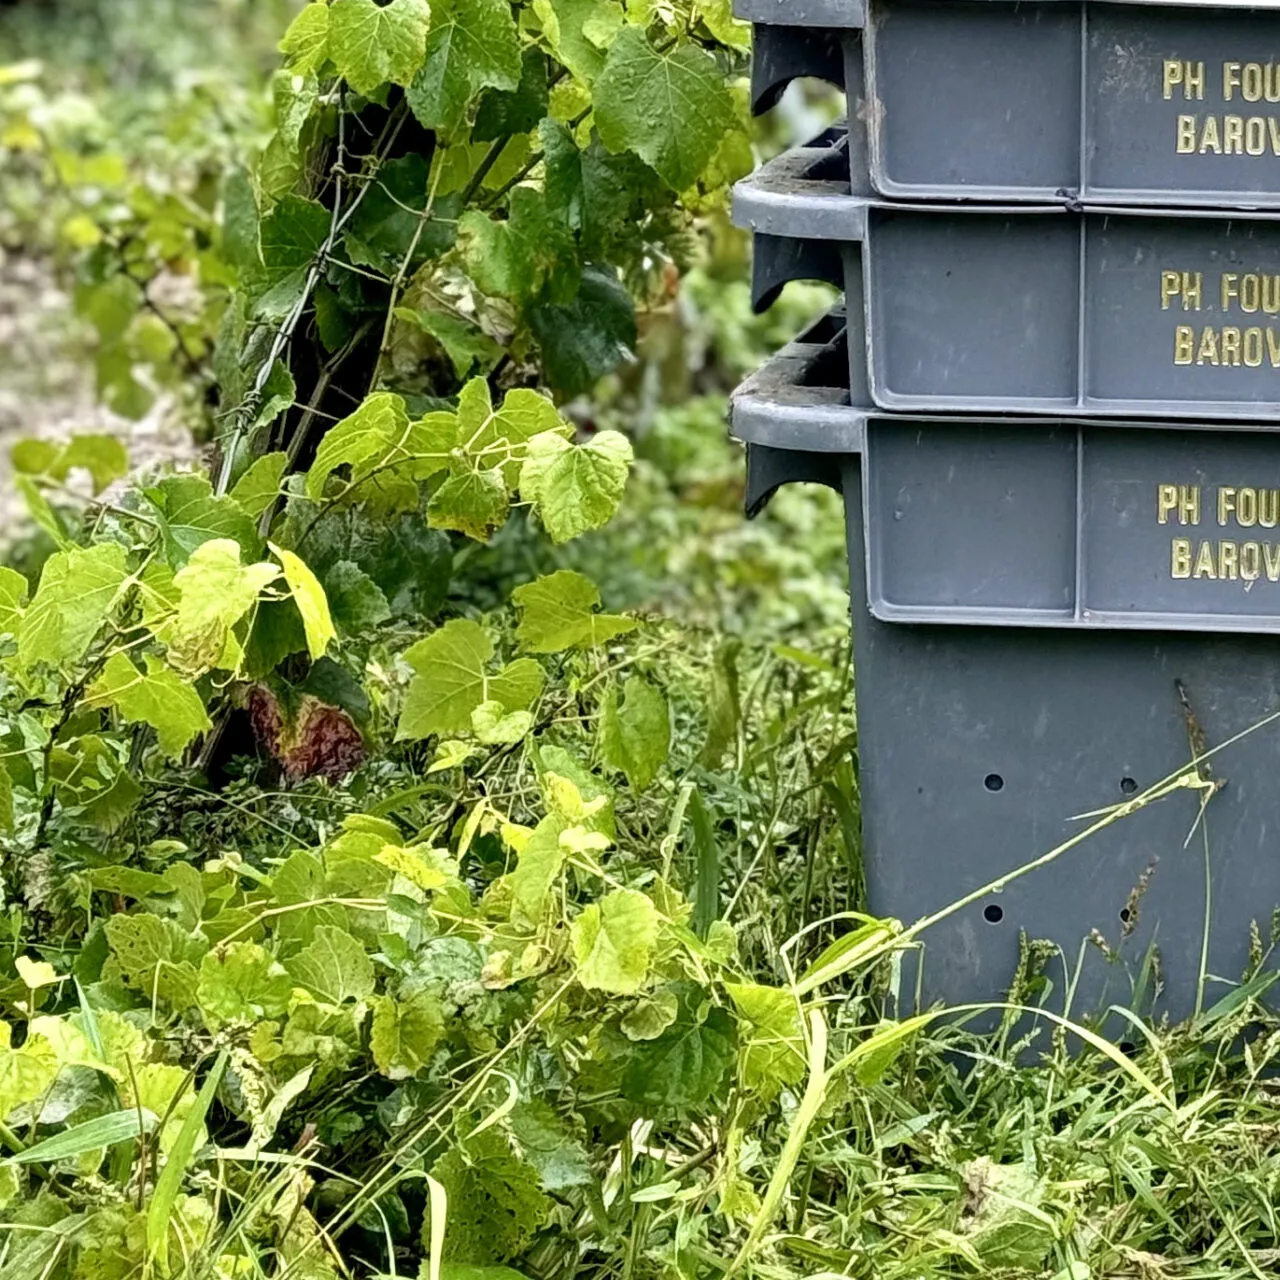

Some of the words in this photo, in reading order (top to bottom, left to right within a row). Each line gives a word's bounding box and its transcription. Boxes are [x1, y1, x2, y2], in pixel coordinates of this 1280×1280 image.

[1162, 60, 1204, 100] PH
[1160, 271, 1202, 310] PH
[1157, 483, 1200, 524] PH
